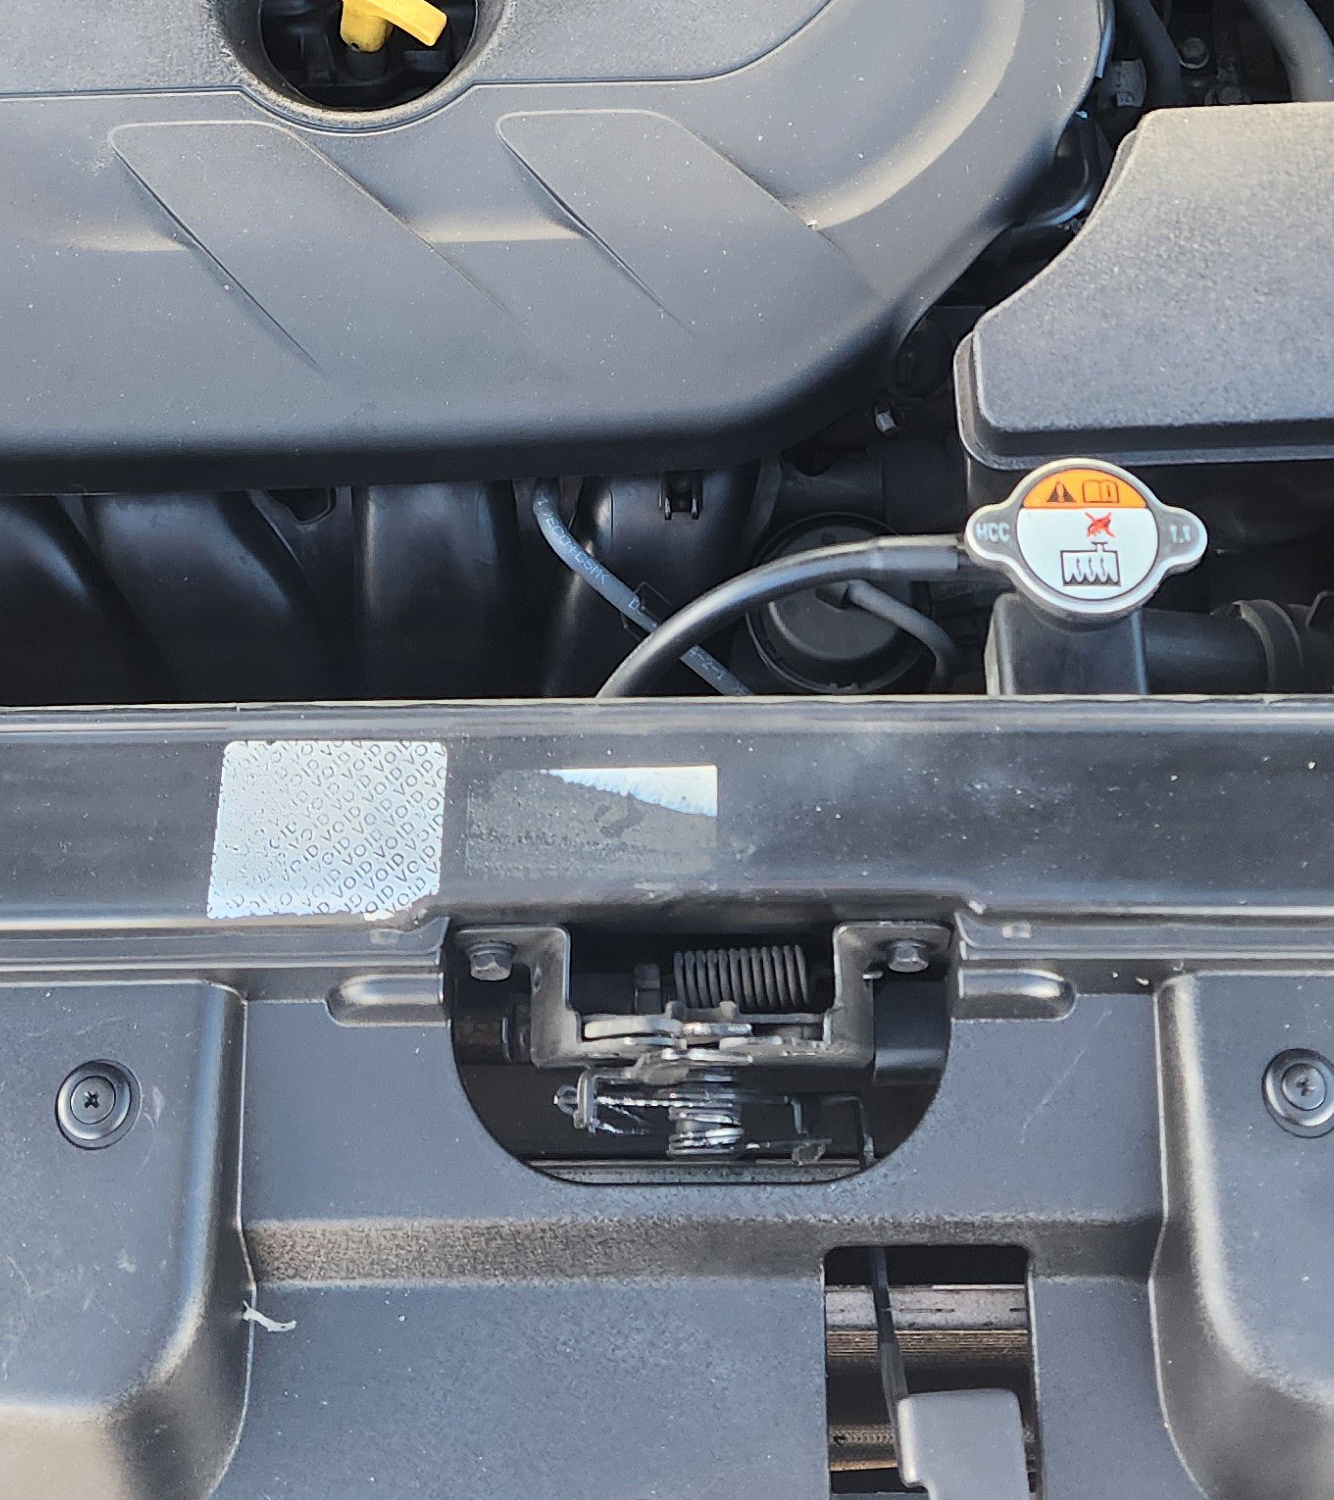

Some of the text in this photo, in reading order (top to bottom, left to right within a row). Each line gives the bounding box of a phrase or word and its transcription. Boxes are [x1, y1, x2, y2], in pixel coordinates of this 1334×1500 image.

[341, 743, 381, 779] VOID
[352, 798, 393, 835] VOID
[393, 760, 434, 797] VOID
[320, 806, 362, 842] VOID
[362, 766, 402, 803] VOID
[342, 829, 383, 866] VOID
[384, 790, 424, 827] VOID
[331, 861, 373, 899] VOID
[373, 821, 415, 859] VOID
[363, 853, 405, 891] VOID
